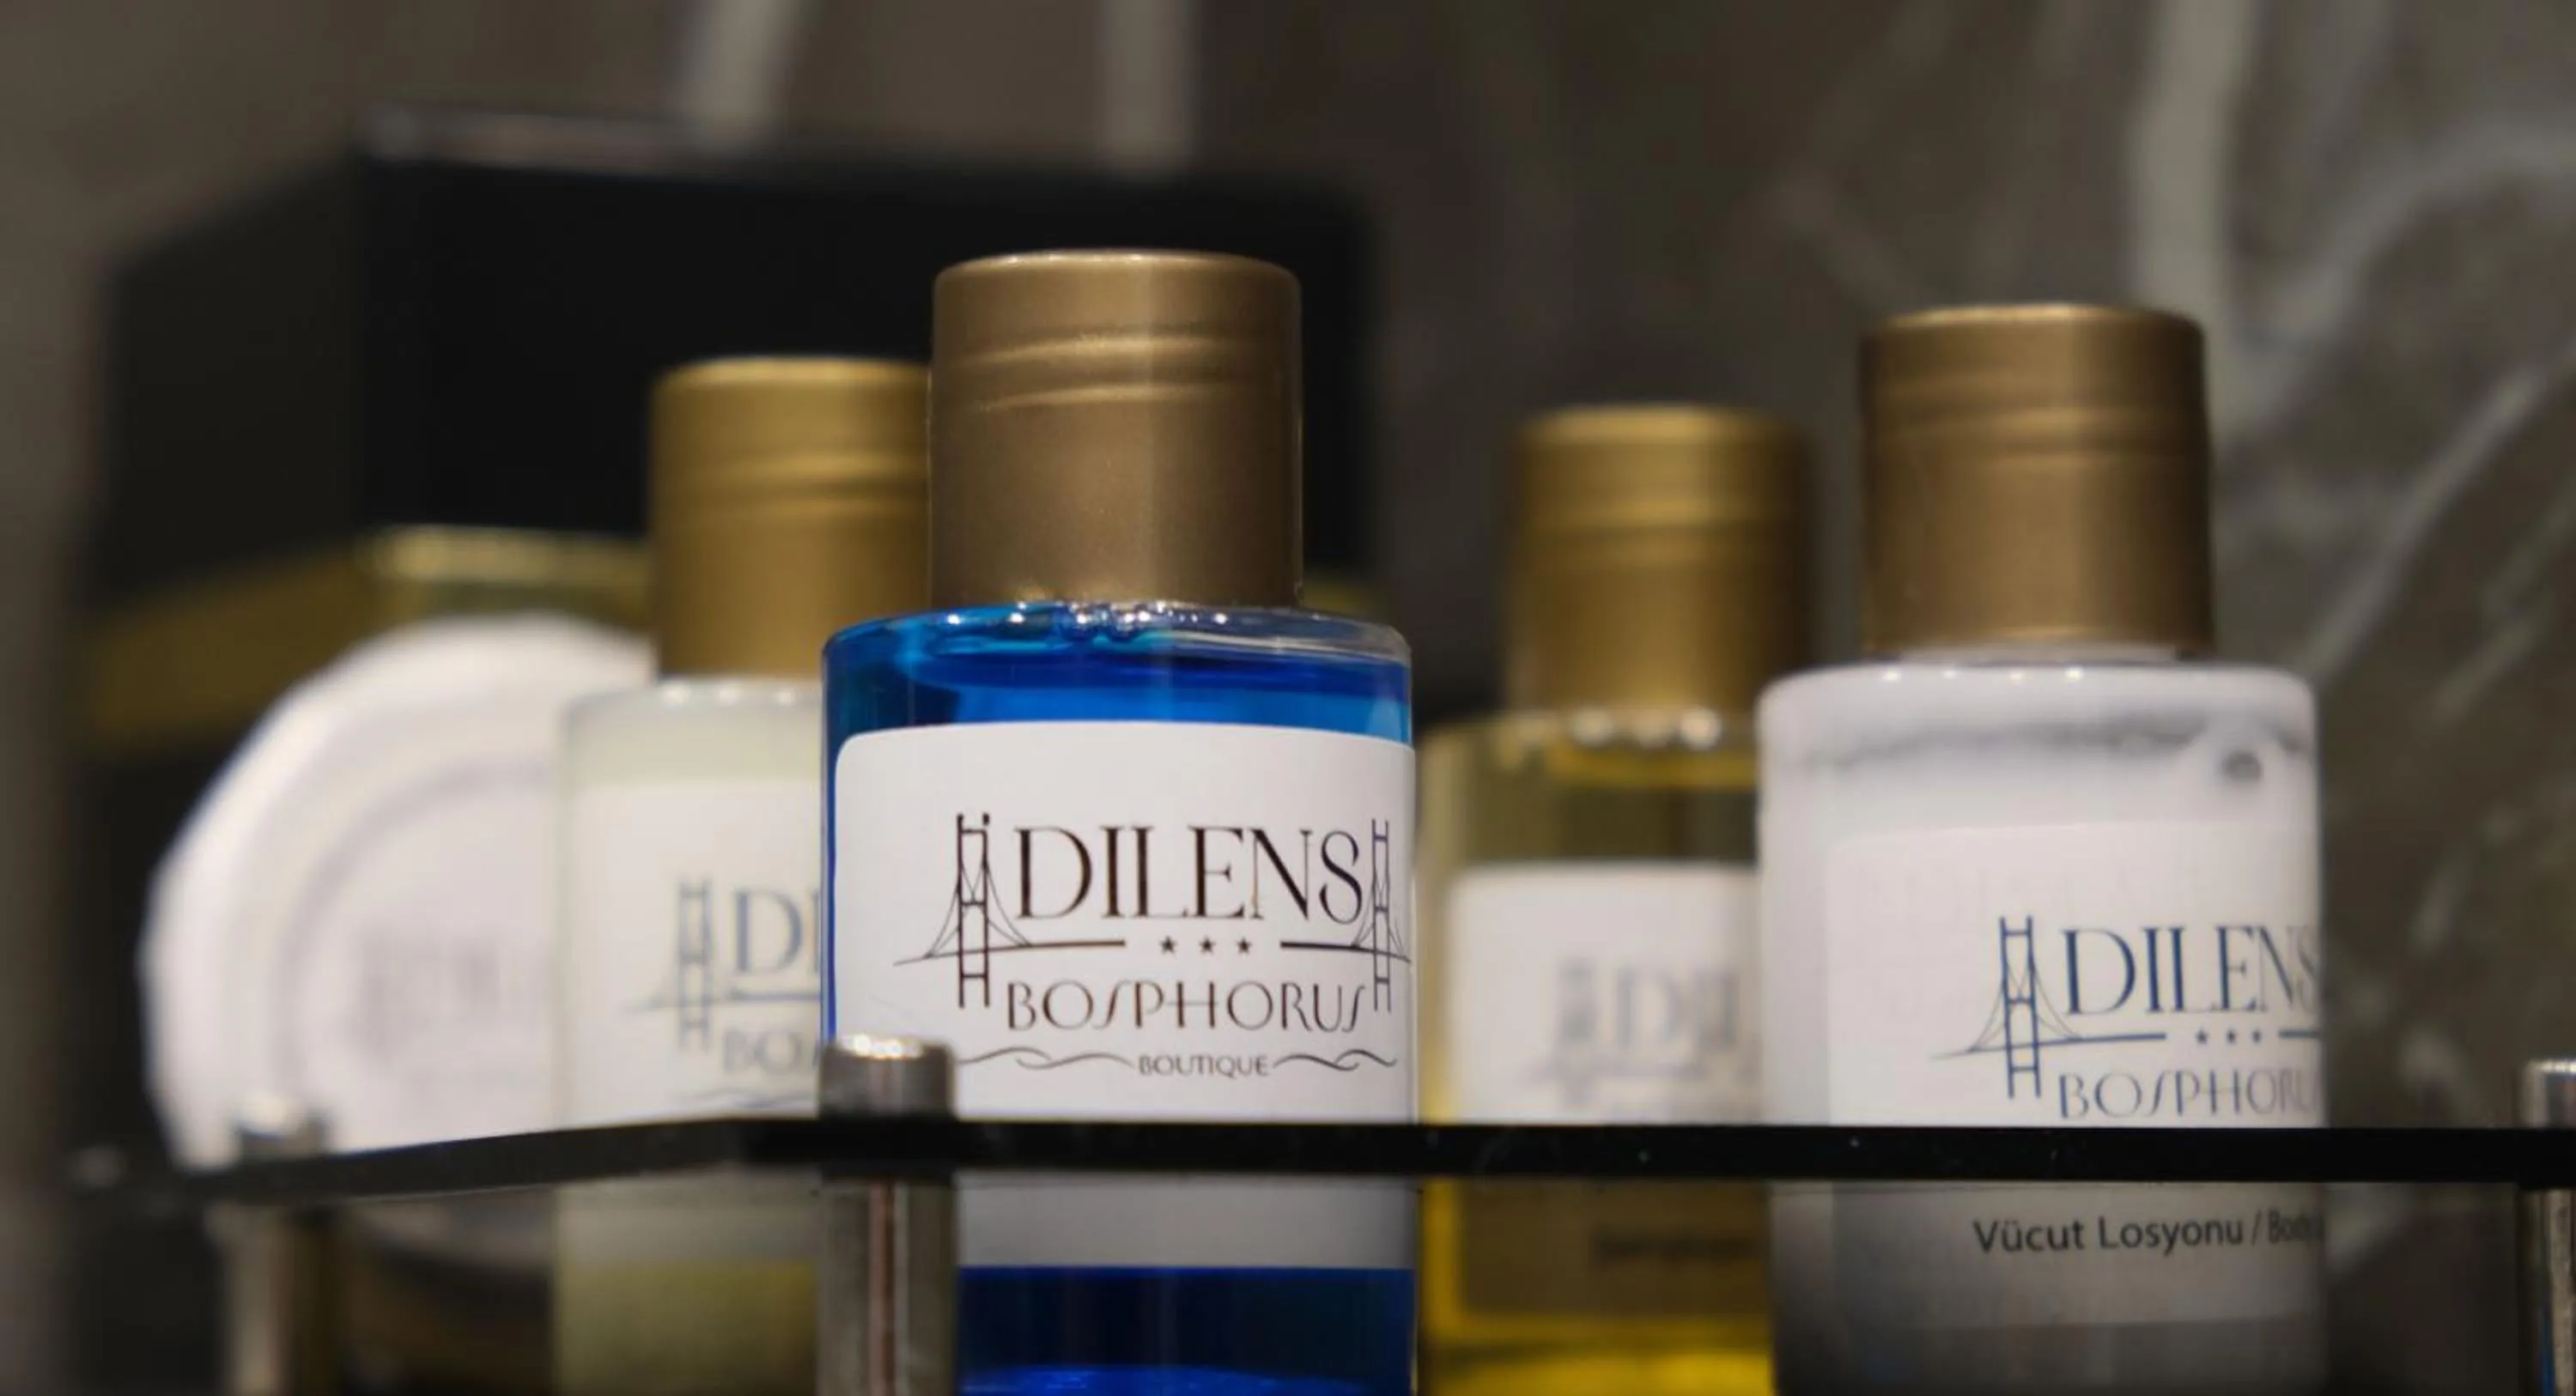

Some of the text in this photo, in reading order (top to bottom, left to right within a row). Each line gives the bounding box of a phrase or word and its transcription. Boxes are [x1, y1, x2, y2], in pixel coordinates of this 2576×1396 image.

[1014, 825, 1363, 924] DILENS
[1006, 980, 1367, 1032] BOSPHORUS
[1139, 1053, 1269, 1080] BOUTIQUE
[1972, 1215, 2084, 1254] Vücut
[2098, 1215, 2244, 1258] Losyonu
